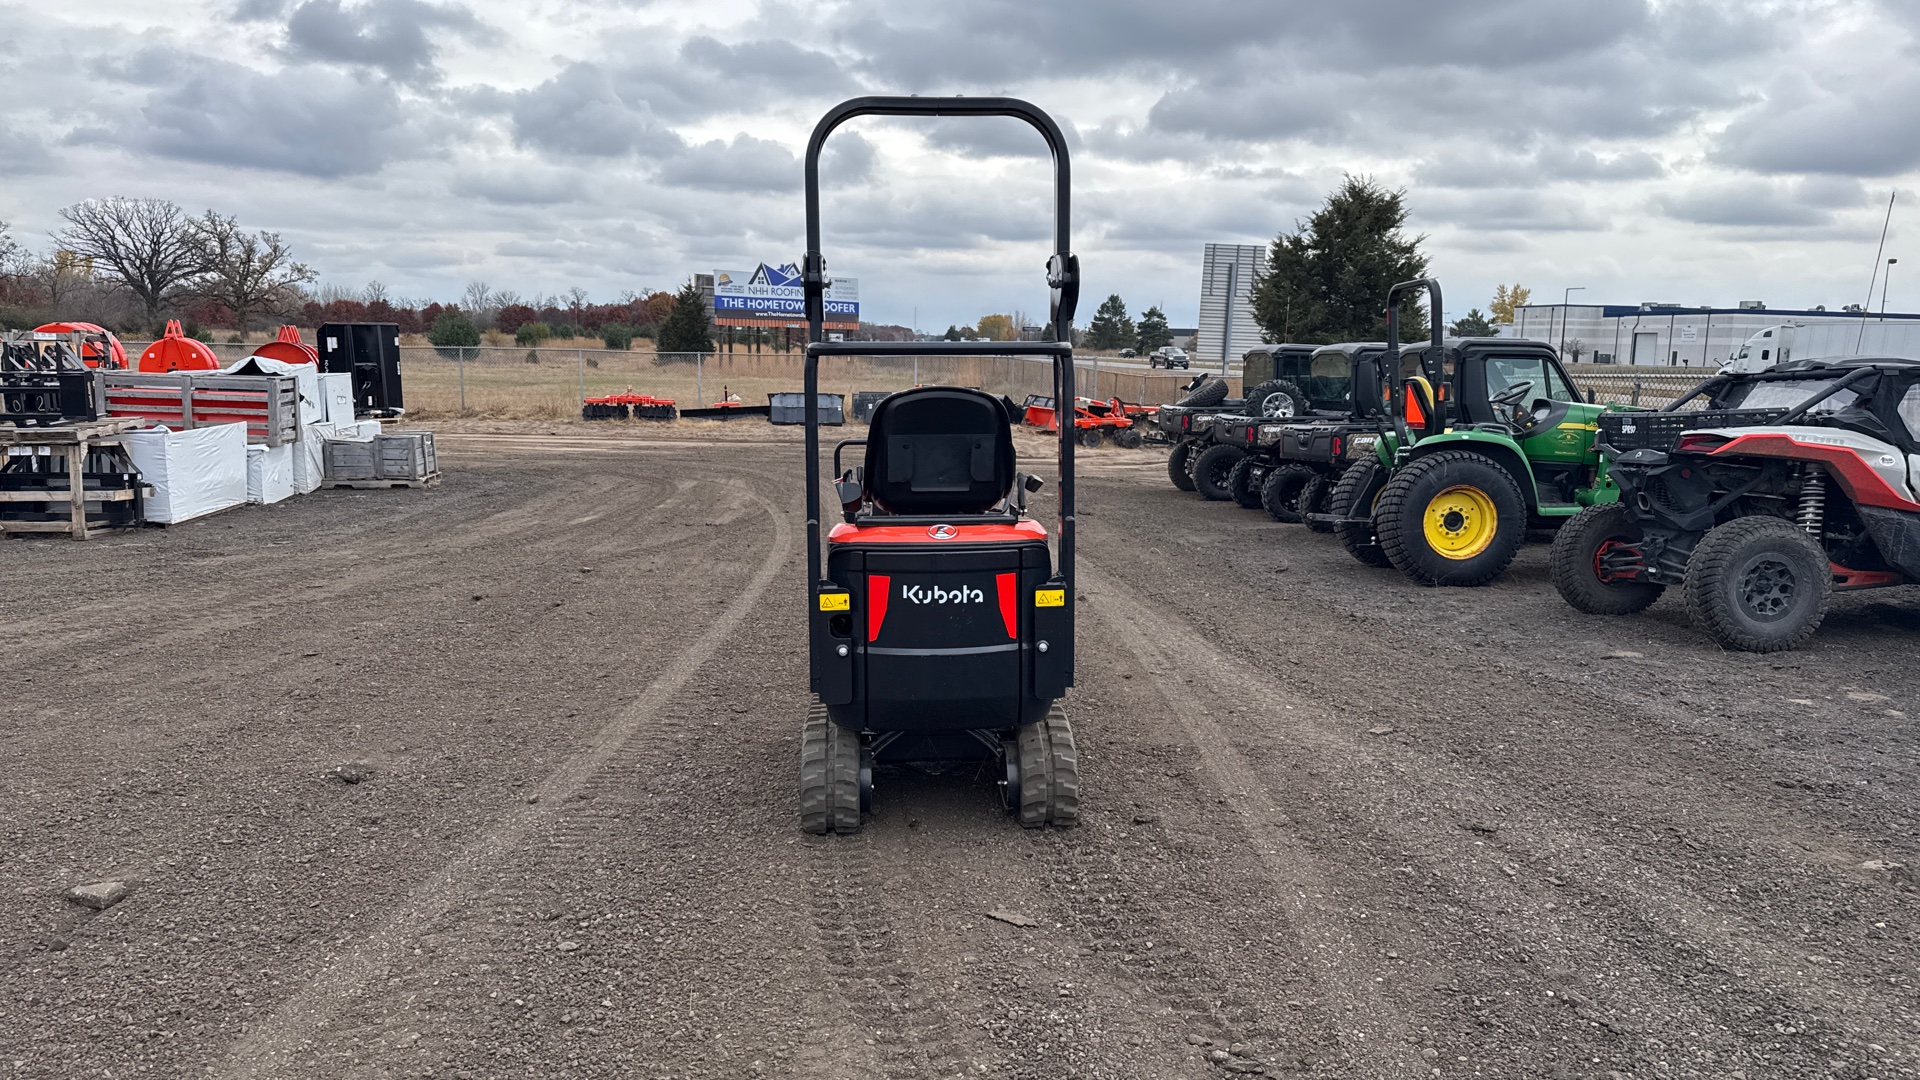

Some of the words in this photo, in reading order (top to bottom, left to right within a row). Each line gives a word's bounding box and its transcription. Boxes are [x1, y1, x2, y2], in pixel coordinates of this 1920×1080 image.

[748, 286, 768, 296] NHH
[771, 287, 804, 297] ROOFIN
[722, 297, 745, 309] THE
[747, 298, 805, 311] HOMETOW
[824, 302, 856, 313] OOFER
[902, 584, 984, 604] Kubota
